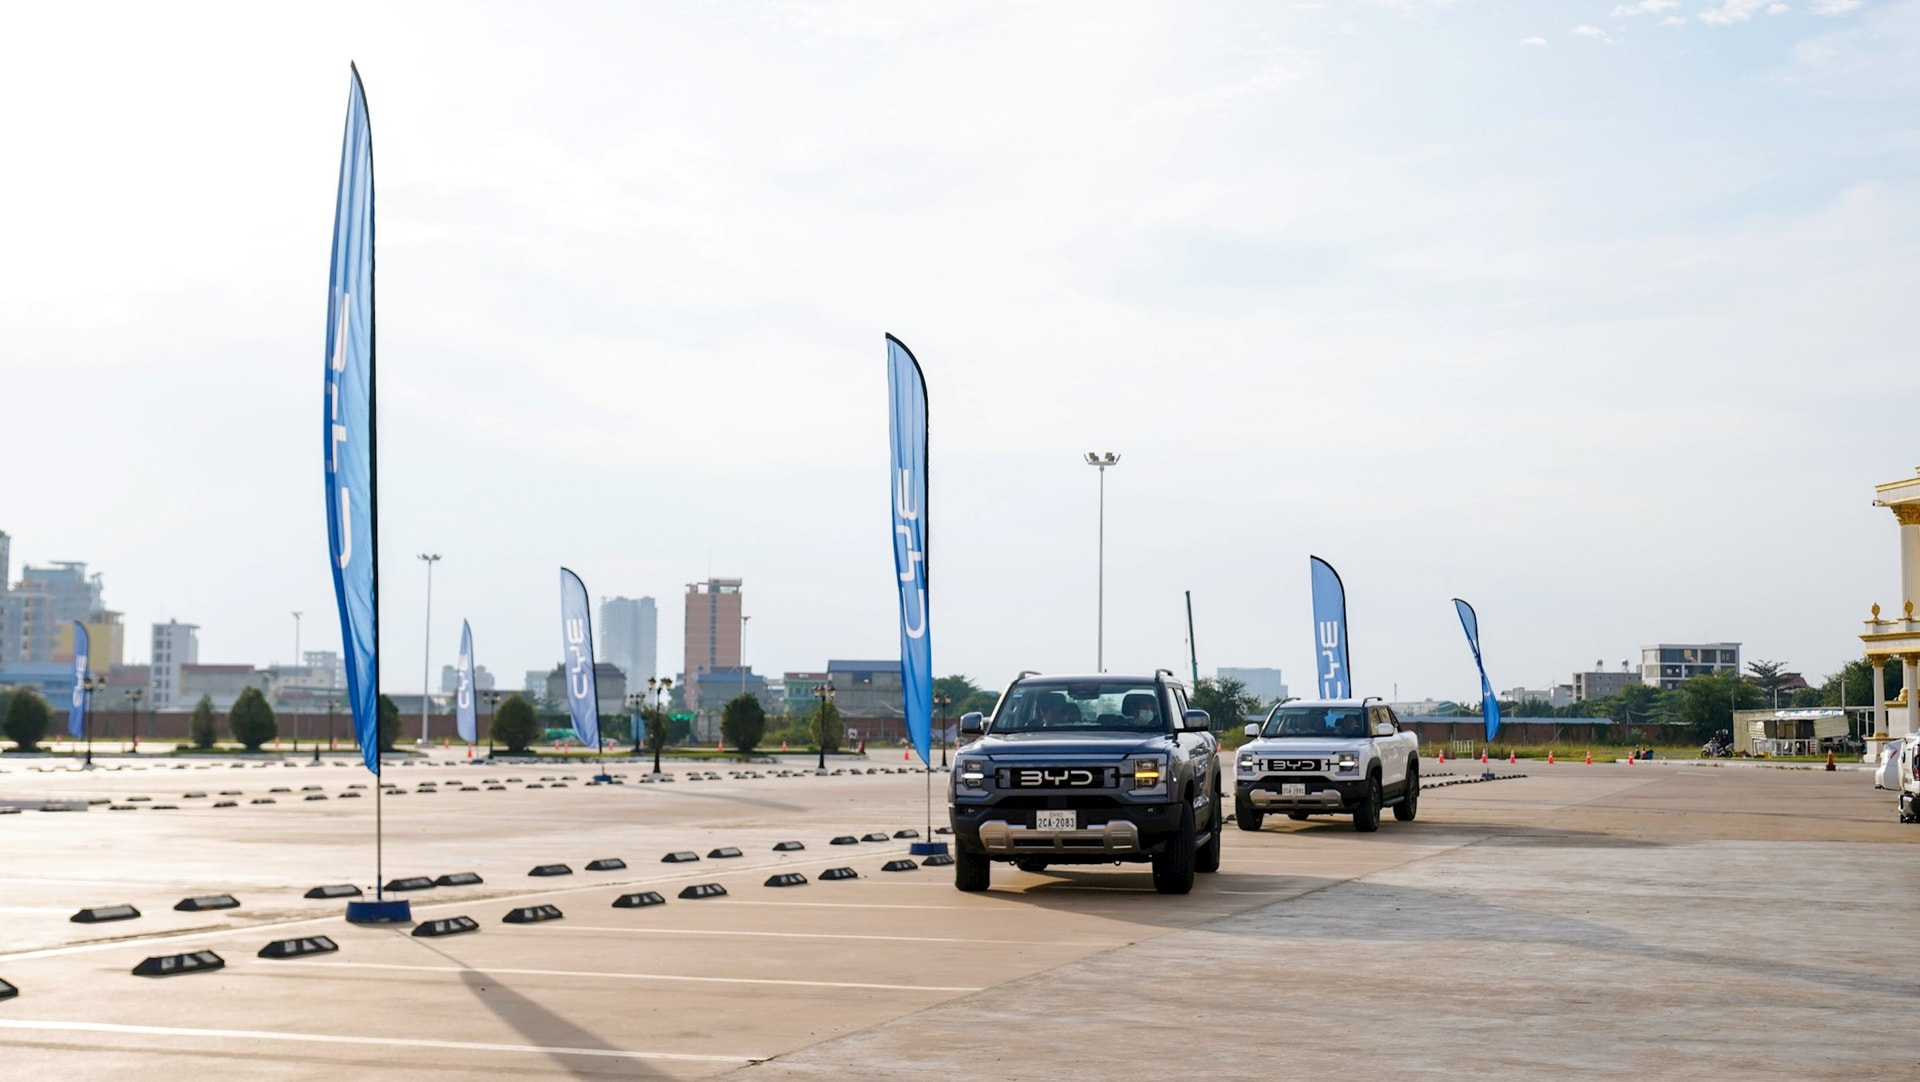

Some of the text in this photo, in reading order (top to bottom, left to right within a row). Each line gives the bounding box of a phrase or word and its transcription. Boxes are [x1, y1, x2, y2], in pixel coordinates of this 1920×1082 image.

[1273, 760, 1315, 770] BYD
[1020, 770, 1093, 786] BYD
[1038, 817, 1075, 828] 2CA-2083
